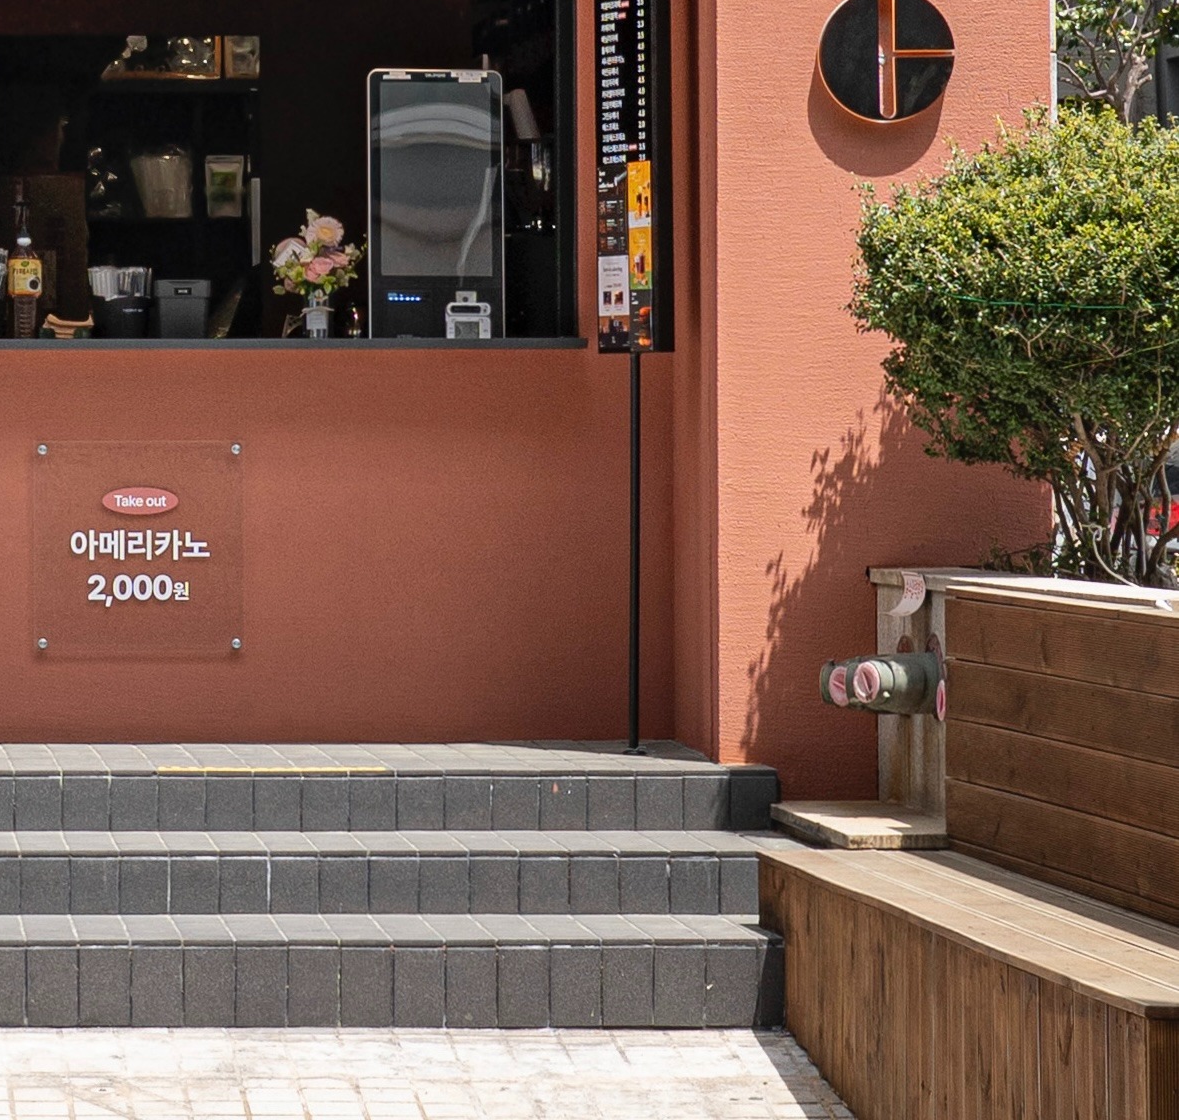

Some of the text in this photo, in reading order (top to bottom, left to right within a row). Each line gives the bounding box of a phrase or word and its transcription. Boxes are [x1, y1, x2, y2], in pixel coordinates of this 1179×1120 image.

[113, 494, 167, 508] Take out
[70, 529, 211, 561] 아메리카노
[87, 574, 190, 608] 2,000원
